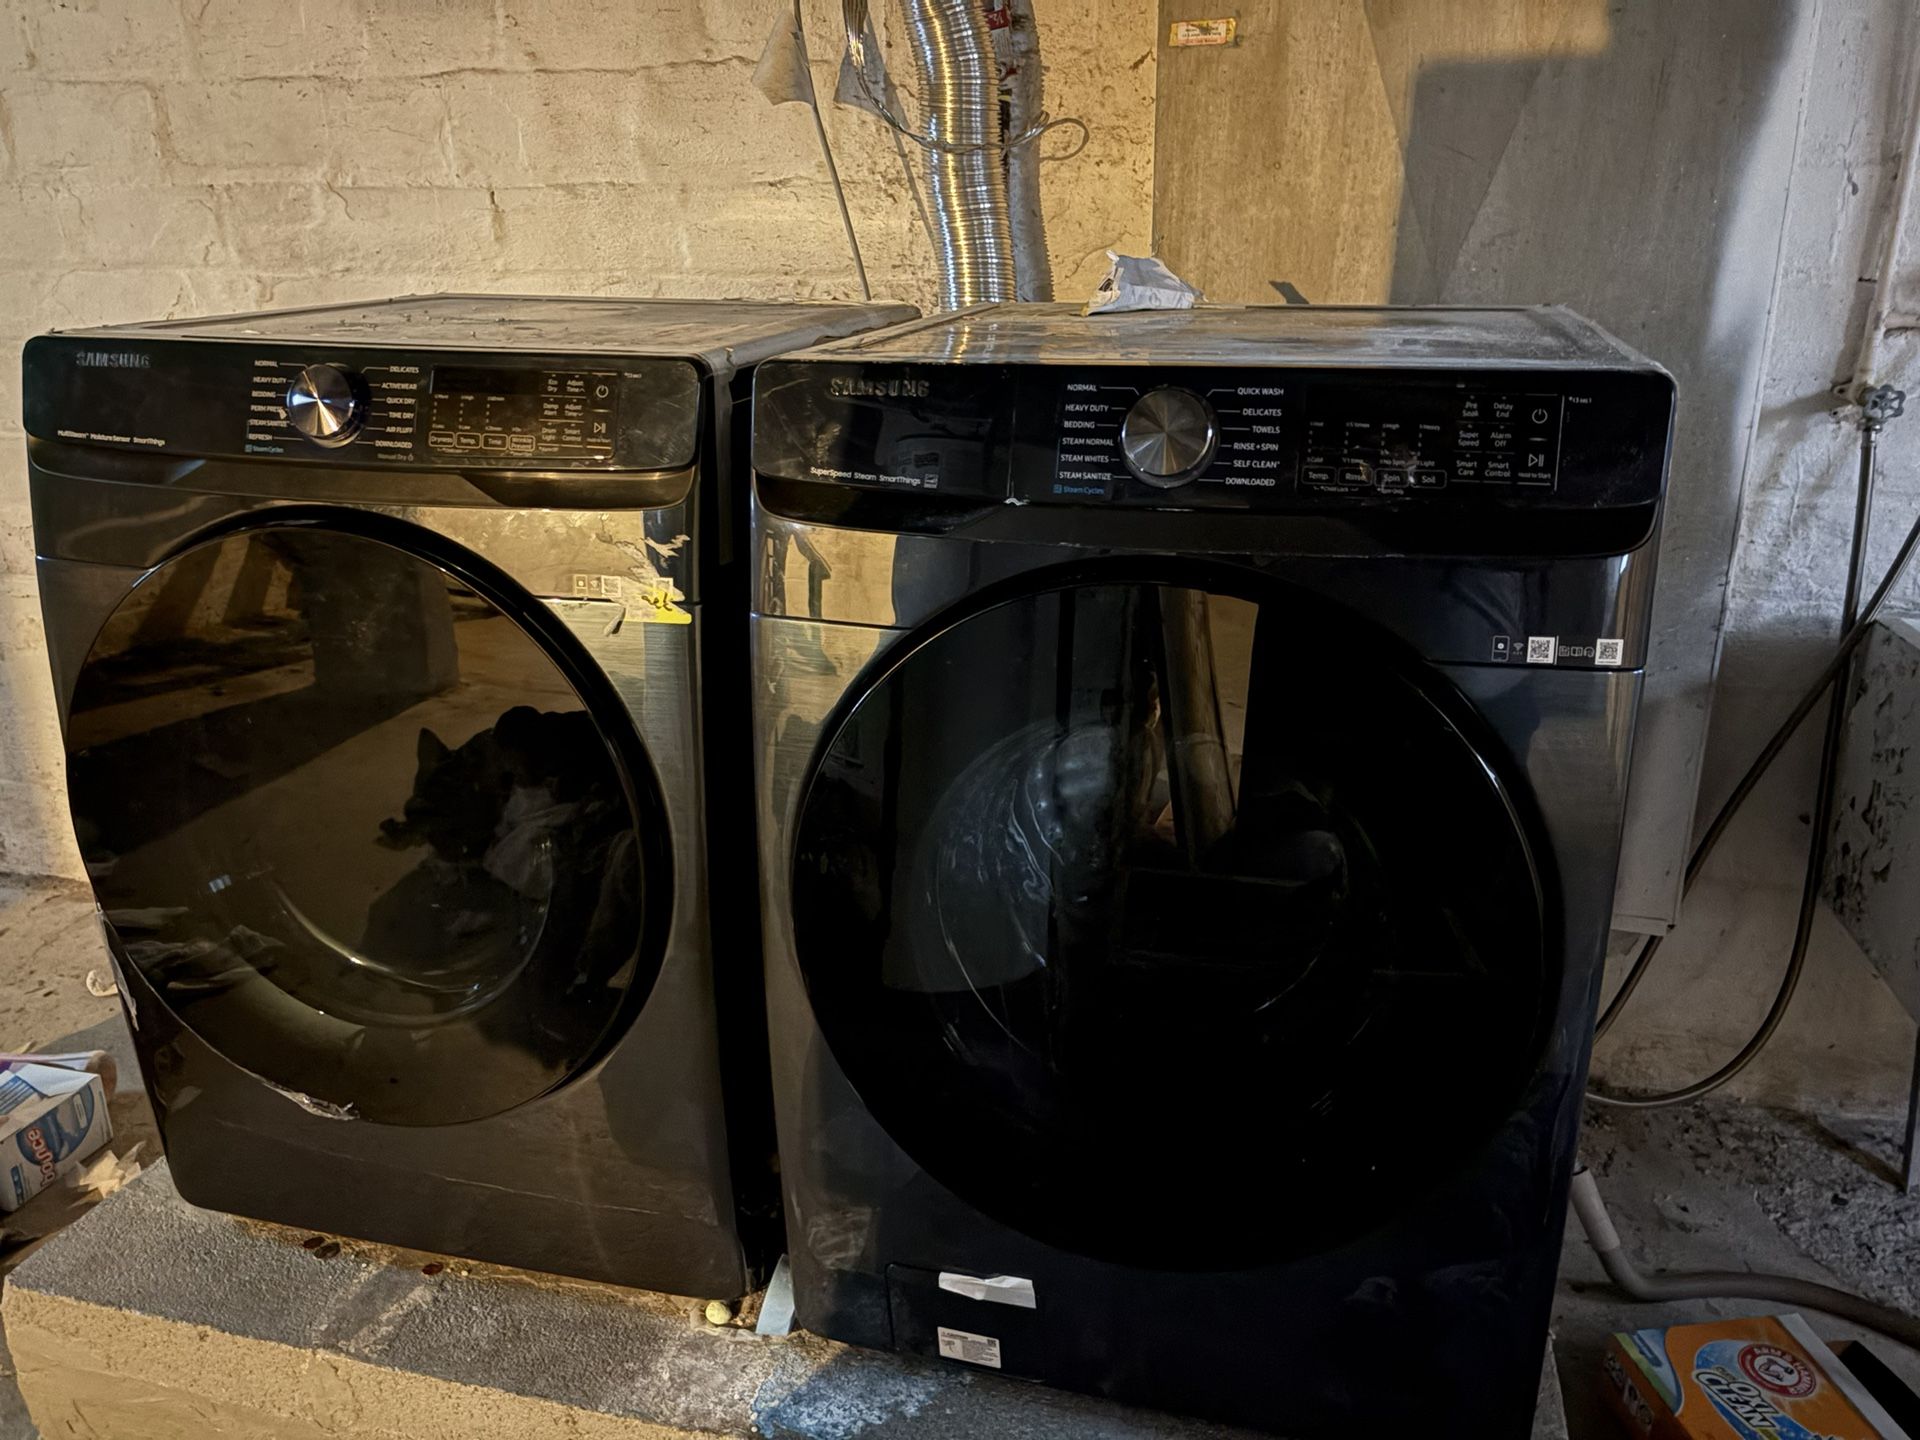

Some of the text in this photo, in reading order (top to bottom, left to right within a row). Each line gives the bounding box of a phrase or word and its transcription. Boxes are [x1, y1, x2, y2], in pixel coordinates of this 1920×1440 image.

[76, 352, 151, 368] SAMSUNG
[254, 360, 278, 368] NORMAL
[389, 366, 419, 374] DELICATES
[382, 382, 418, 390] ACTIVEWEAR
[831, 378, 930, 397] SAMSUNG
[1067, 384, 1098, 392] NORMAL
[1237, 387, 1284, 396] QUICK WASH
[1065, 403, 1109, 412] HEAVY DUTY
[1242, 407, 1282, 417] DELICATES
[1063, 420, 1095, 429] BEDDING
[1252, 425, 1281, 434] TOWELS
[1490, 431, 1512, 440] Alarm
[375, 440, 413, 449] DOWNLOADED
[1062, 437, 1114, 446] STEAM NORMAL
[1494, 439, 1507, 448] Off
[1233, 442, 1255, 450] RINSE
[1260, 442, 1279, 451] SPIN
[1060, 454, 1109, 463] STEAM WHITES
[1233, 459, 1251, 468] SELF
[1456, 459, 1478, 468] Smart
[1487, 461, 1510, 470] Smart
[1059, 471, 1112, 481] STEAM SANITIZE
[1457, 467, 1475, 476] Care
[1484, 469, 1512, 478] Control
[810, 466, 852, 478] SuperSpeed
[854, 471, 877, 481] Steam
[879, 474, 921, 487] SmartThings
[1384, 474, 1401, 483] Spin
[1225, 477, 1276, 487] DOWNLOADED
[27, 1127, 57, 1188] bounce
[1695, 1371, 1777, 1428] CLEAN
[1727, 1381, 1780, 1415] OXI
